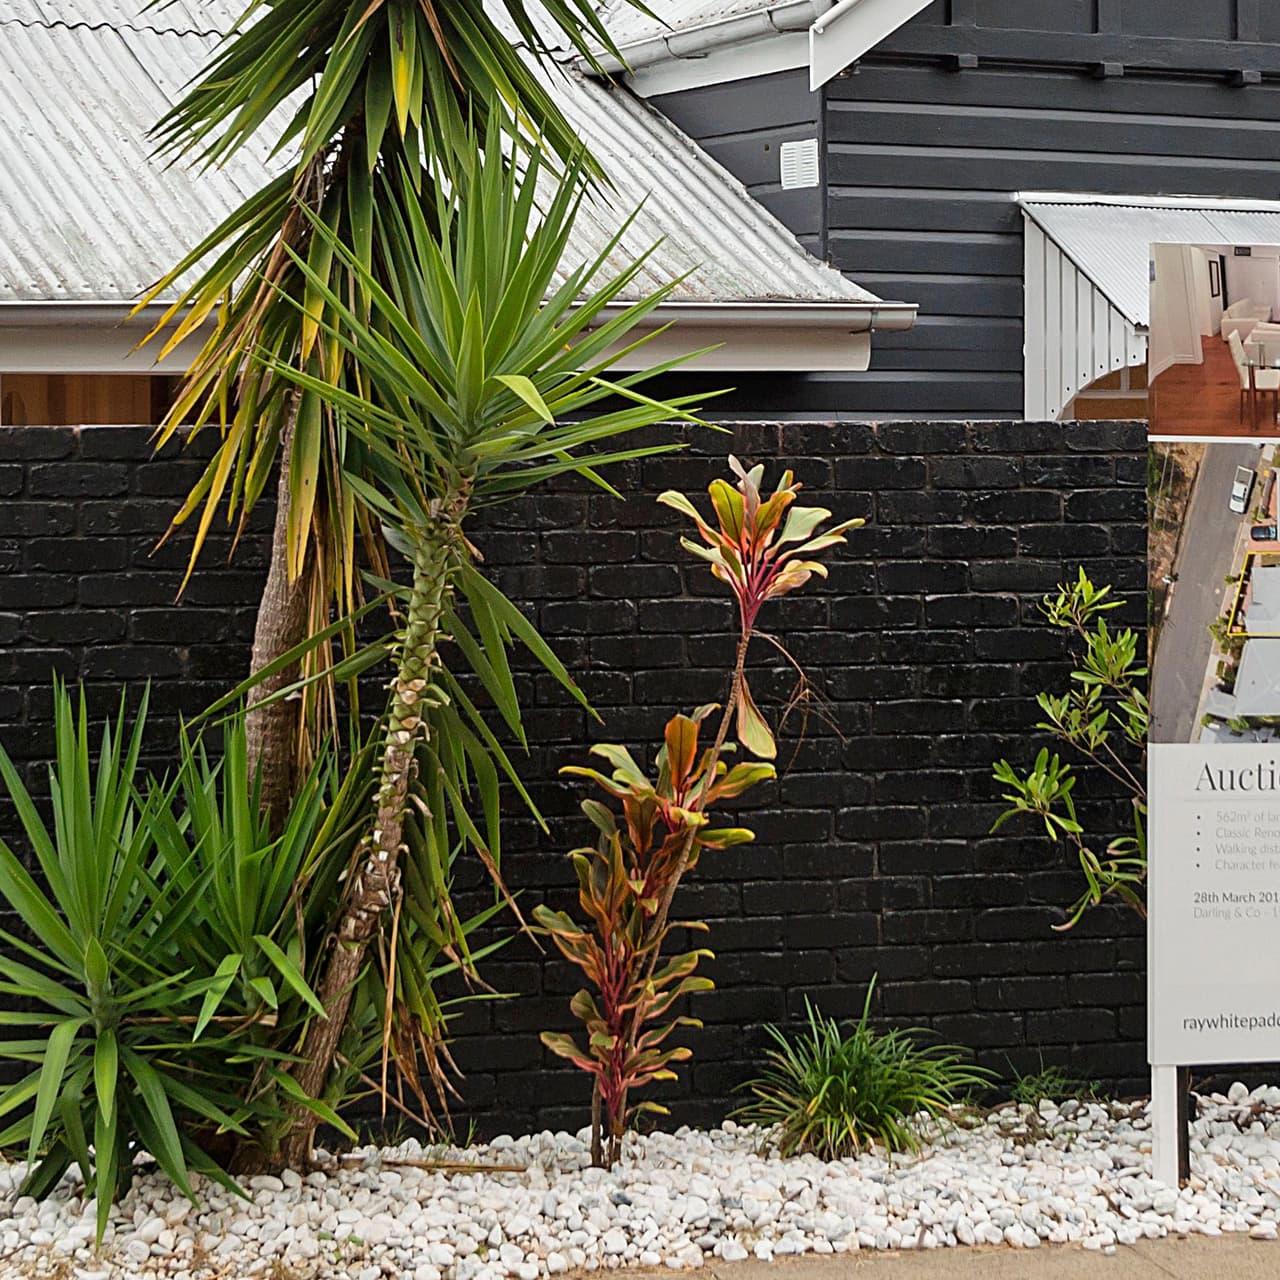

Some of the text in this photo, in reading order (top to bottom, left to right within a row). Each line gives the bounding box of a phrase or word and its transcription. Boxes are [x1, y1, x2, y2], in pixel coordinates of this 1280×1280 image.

[1254, 811, 1264, 822] of
[1215, 827, 1249, 839] Classic
[1215, 843, 1257, 856] Walking
[1215, 860, 1265, 871] Character
[1193, 892, 1219, 903] 28th
[1222, 892, 1255, 903] March
[1193, 906, 1231, 920] Darling
[1234, 907, 1243, 918] &
[1245, 907, 1261, 918] Co
